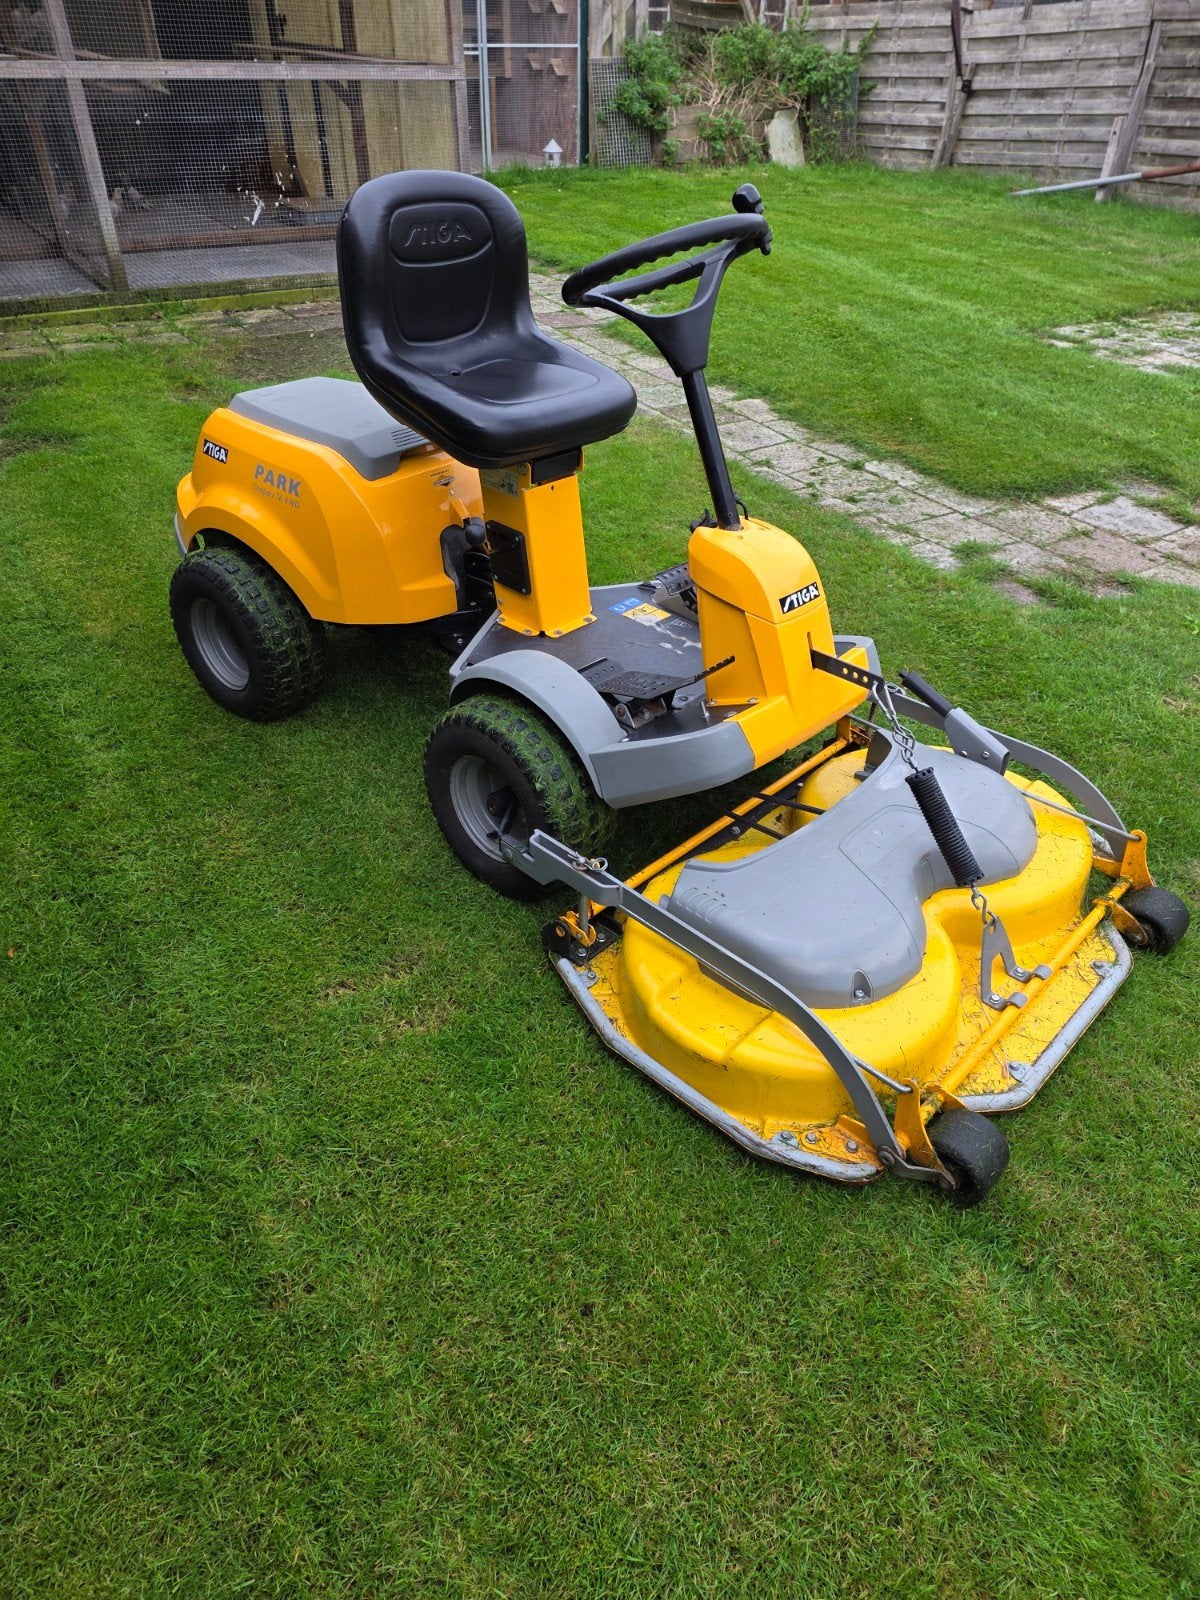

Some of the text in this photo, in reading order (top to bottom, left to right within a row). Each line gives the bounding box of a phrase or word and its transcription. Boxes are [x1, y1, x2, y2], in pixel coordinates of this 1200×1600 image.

[404, 218, 472, 246] STIGA
[203, 441, 227, 463] STIGA
[254, 464, 301, 497] PARK
[782, 584, 820, 612] STIGA
